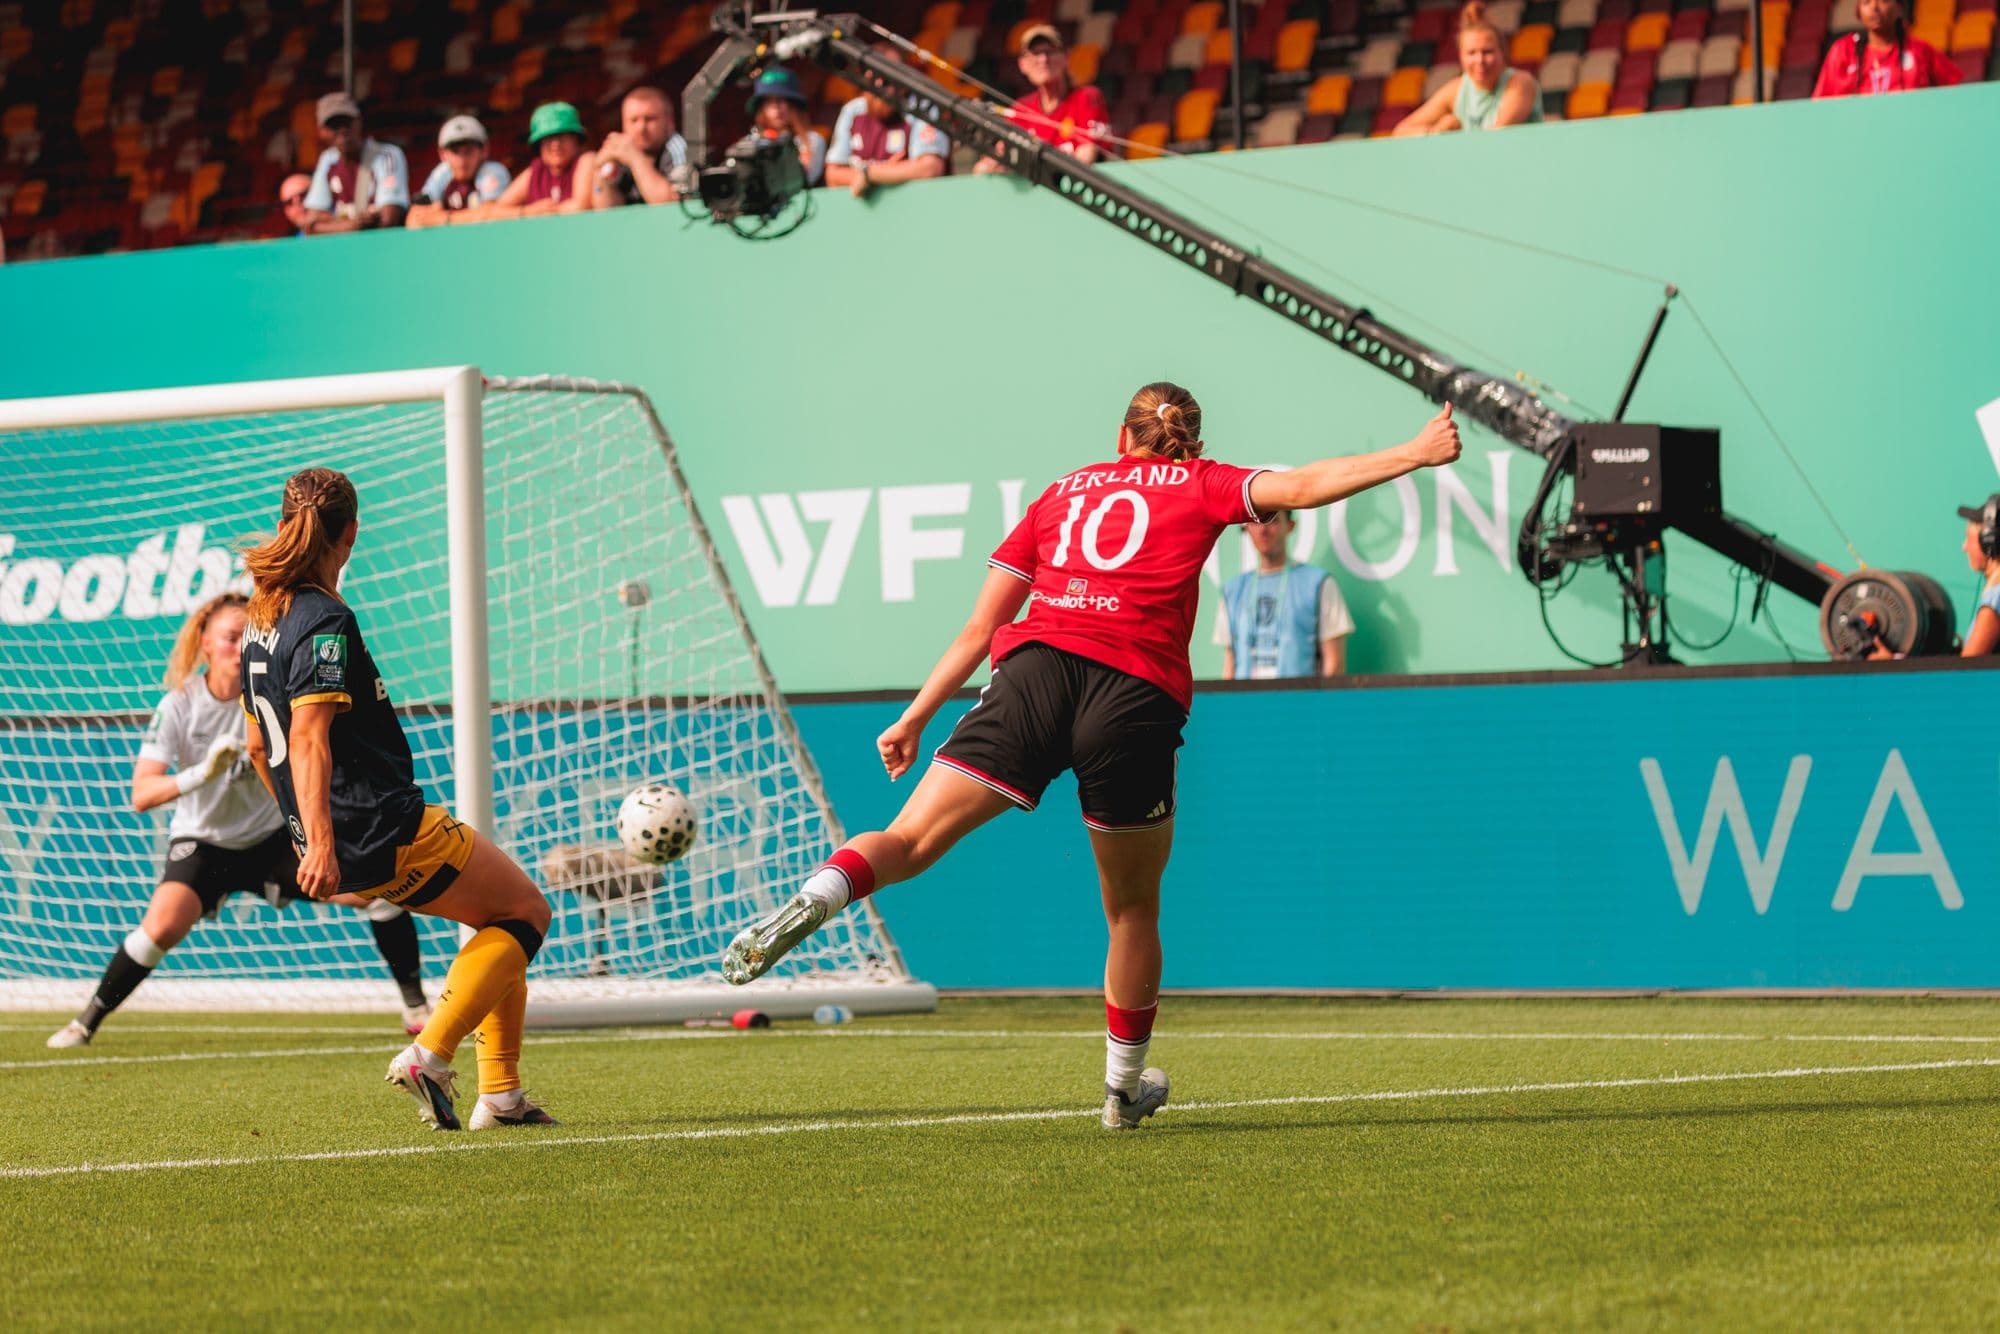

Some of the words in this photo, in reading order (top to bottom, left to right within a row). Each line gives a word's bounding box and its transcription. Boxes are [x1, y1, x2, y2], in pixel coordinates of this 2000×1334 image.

[1056, 465, 1189, 496] TERLAND
[0, 522, 256, 626] ootb
[1052, 489, 1149, 570] 10
[1639, 748, 1964, 915] WA
